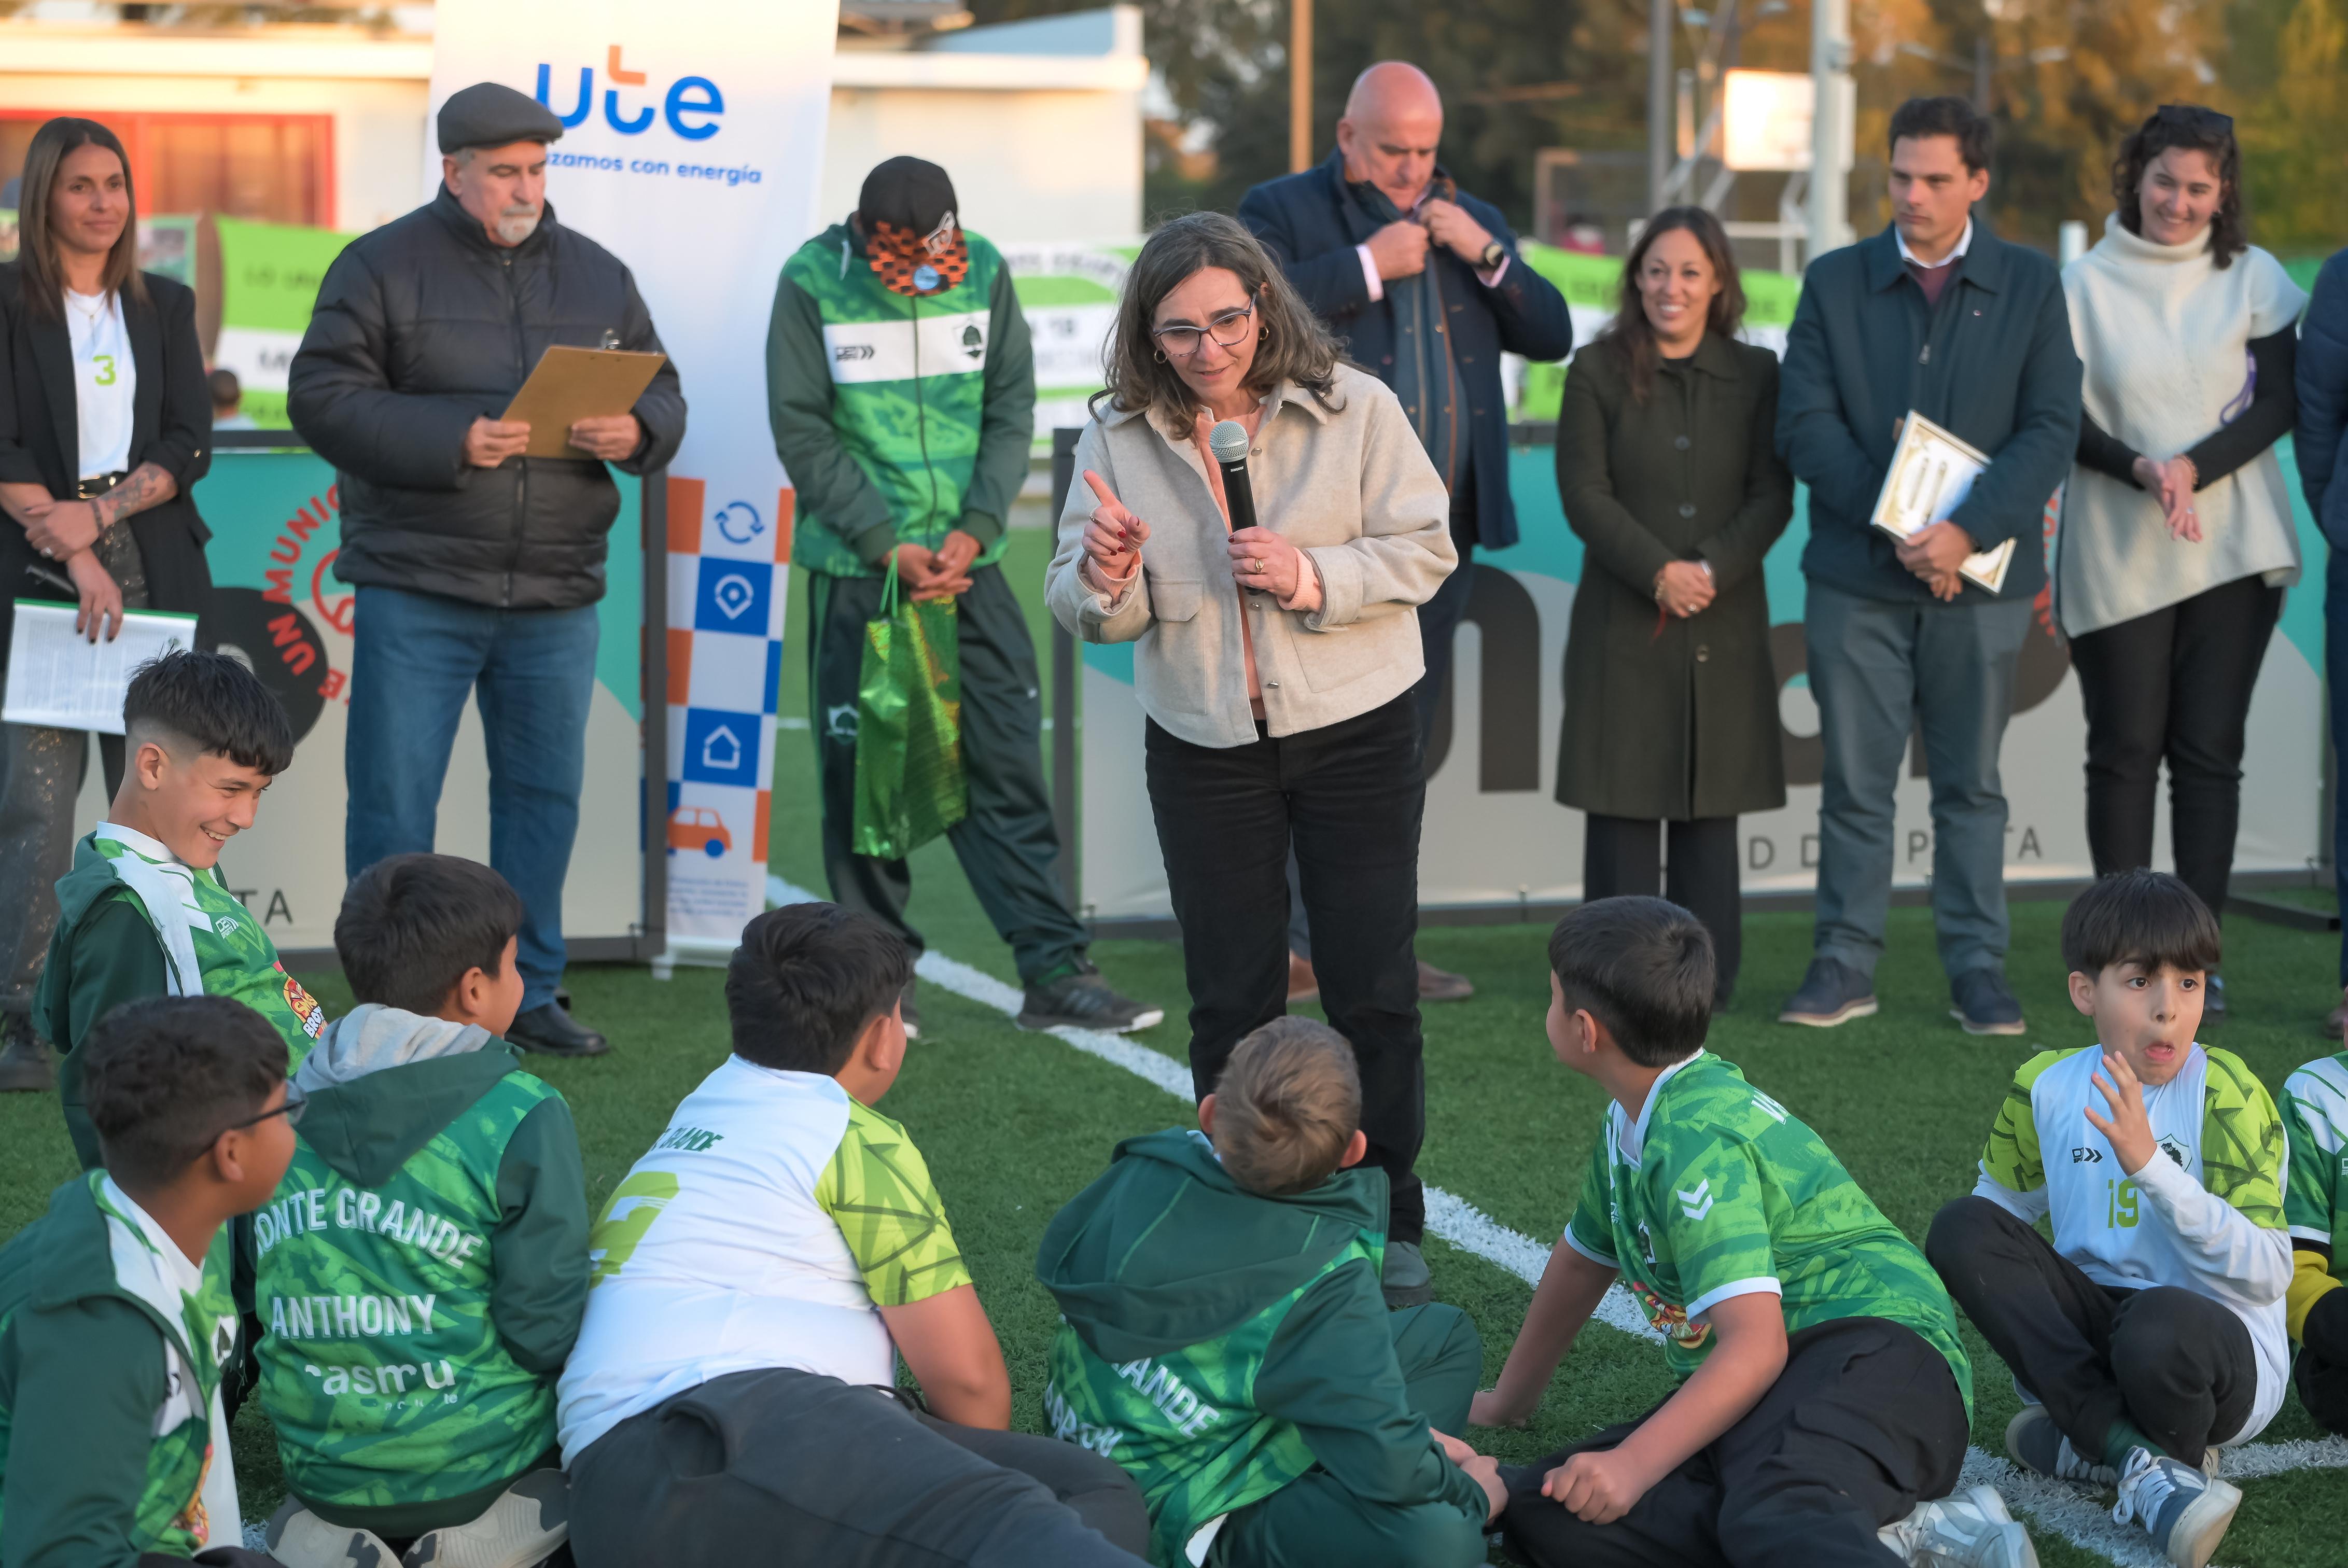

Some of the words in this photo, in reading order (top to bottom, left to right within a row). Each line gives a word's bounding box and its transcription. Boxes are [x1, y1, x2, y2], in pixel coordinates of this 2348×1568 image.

[536, 45, 724, 141] ute
[547, 152, 622, 172] zamos
[631, 159, 670, 175] con
[677, 164, 762, 187] energía
[93, 355, 117, 386] 3
[267, 613, 316, 676] UN
[254, 1188, 328, 1260] ONTE
[334, 1187, 484, 1270] GRANDE
[2107, 1178, 2140, 1228] 19
[271, 1293, 437, 1340] ANTHONY
[1111, 1356, 1221, 1440] ANDE
